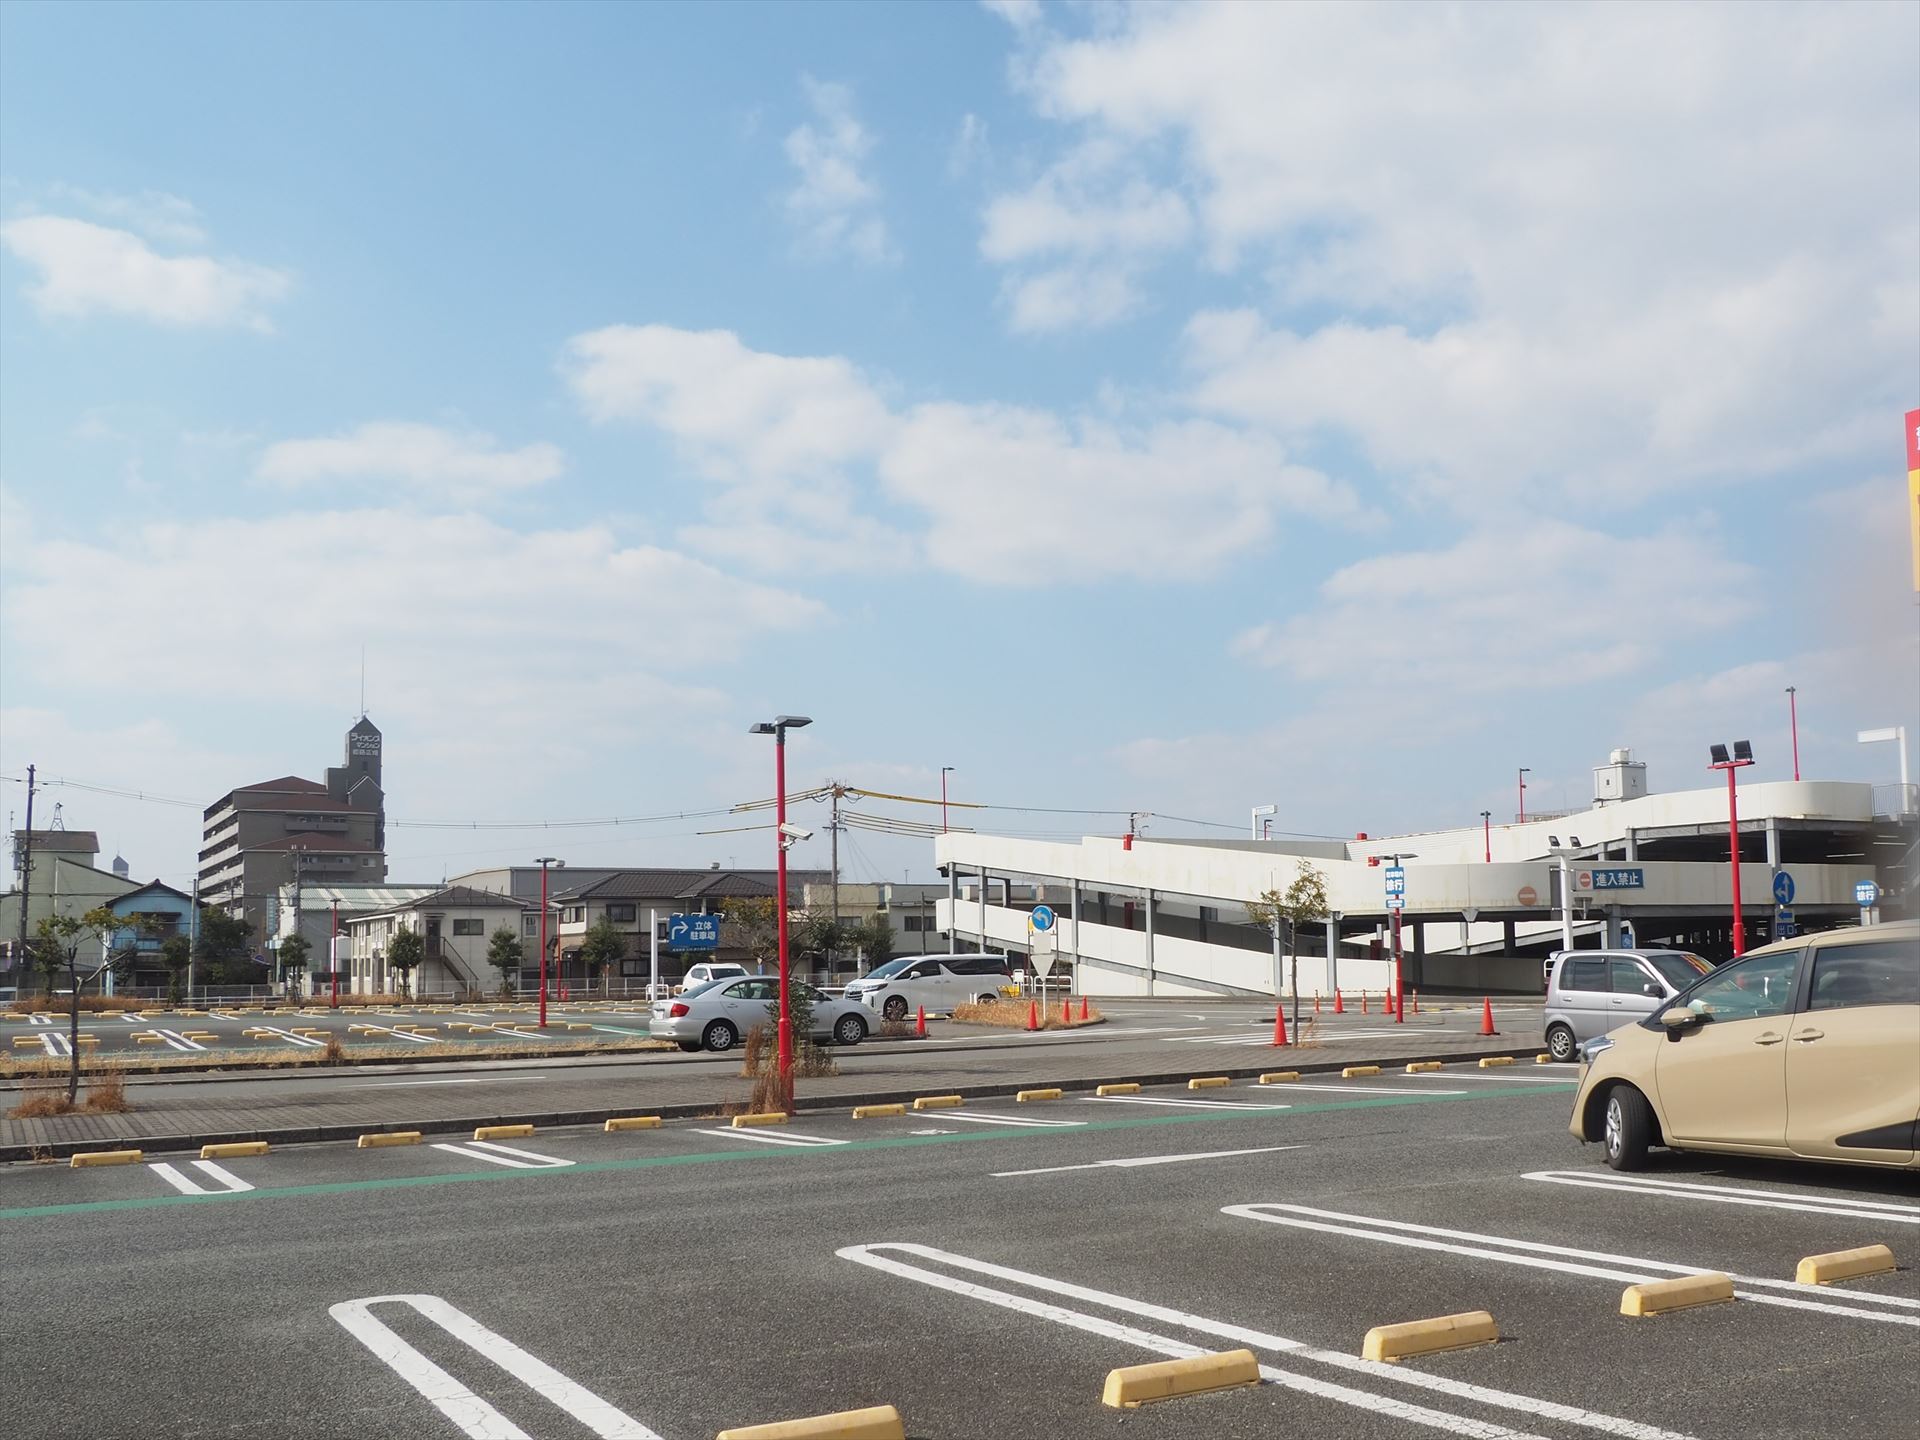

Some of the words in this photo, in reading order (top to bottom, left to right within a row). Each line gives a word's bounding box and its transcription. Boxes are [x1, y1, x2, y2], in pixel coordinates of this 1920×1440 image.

[1596, 872, 1639, 886] 進入禁止
[1857, 890, 1874, 901] 徐行
[695, 921, 712, 931] 立体
[690, 931, 716, 941] 駐車場
